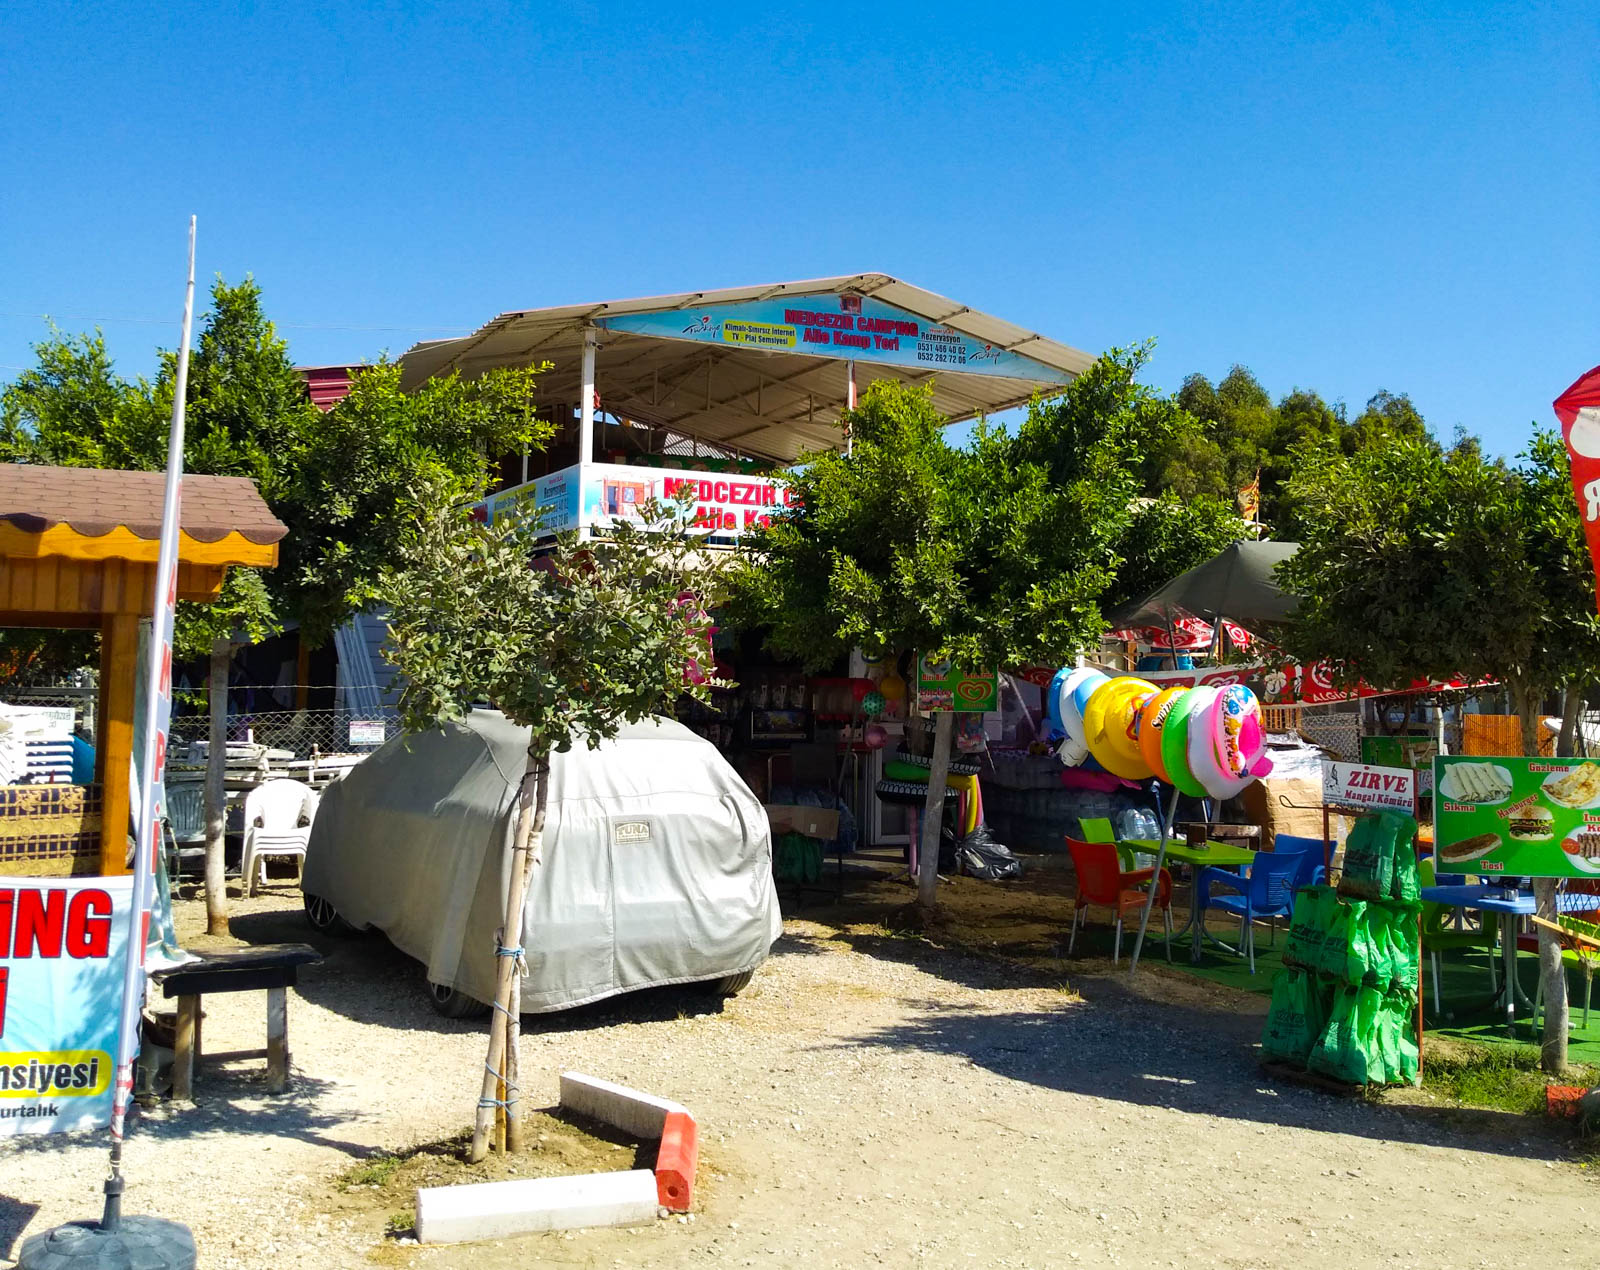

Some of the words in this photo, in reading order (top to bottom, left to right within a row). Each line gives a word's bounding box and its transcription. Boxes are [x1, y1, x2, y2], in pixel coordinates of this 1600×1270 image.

[803, 328, 830, 344] Aile
[834, 331, 870, 349] Kamp
[874, 335, 899, 351] Yeri
[921, 332, 960, 344] Rezervasyon
[917, 343, 933, 352] 0531
[917, 352, 933, 361] 0532
[1347, 766, 1408, 793] ZİRVE
[1344, 789, 1375, 803] Mangal
[1377, 793, 1412, 807] Kömürü
[1497, 794, 1539, 819] Hamburger
[1481, 860, 1503, 870] Tost
